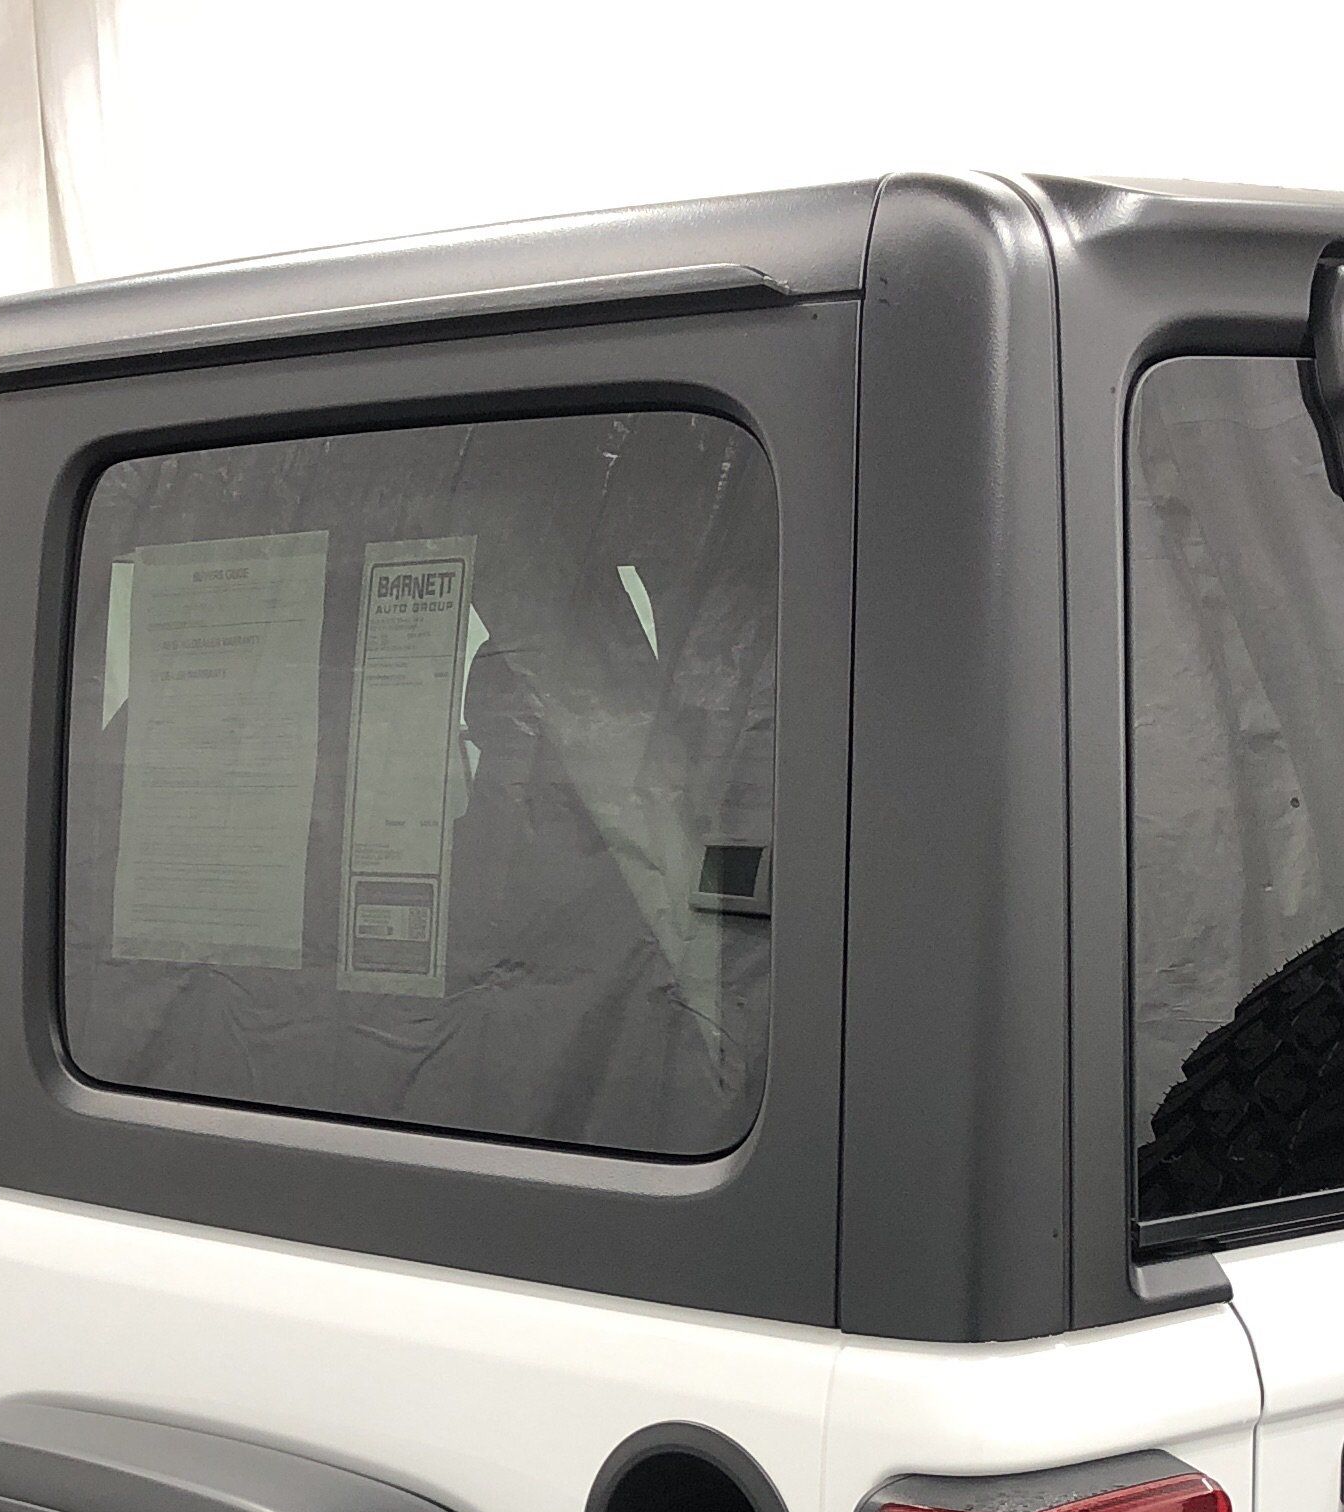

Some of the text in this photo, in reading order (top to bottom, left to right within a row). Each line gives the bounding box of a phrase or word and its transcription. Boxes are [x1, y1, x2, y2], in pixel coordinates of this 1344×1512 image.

[377, 572, 455, 600] BARNETT
[376, 602, 454, 614] AUTO GROUP
